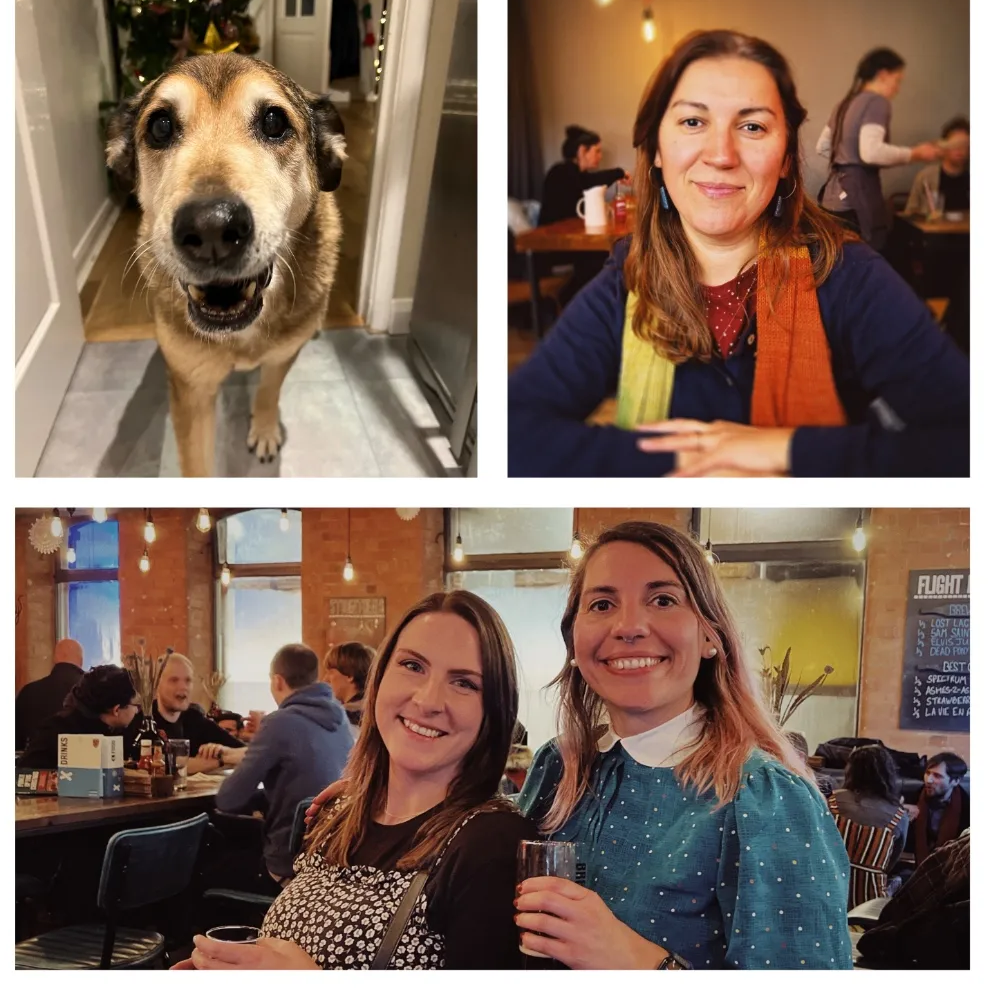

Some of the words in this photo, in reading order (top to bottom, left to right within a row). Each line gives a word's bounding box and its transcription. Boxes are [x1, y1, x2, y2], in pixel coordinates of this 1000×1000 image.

[917, 574, 964, 595] FLIGHT
[930, 619, 951, 628] LOST
[930, 638, 954, 647] ELVIS
[930, 647, 951, 656] DEAD
[943, 661, 967, 673] BEST
[926, 674, 967, 685] SPECTRUM
[937, 706, 950, 717] VIE
[952, 706, 965, 717] EN
[60, 737, 68, 765] DRINKS
